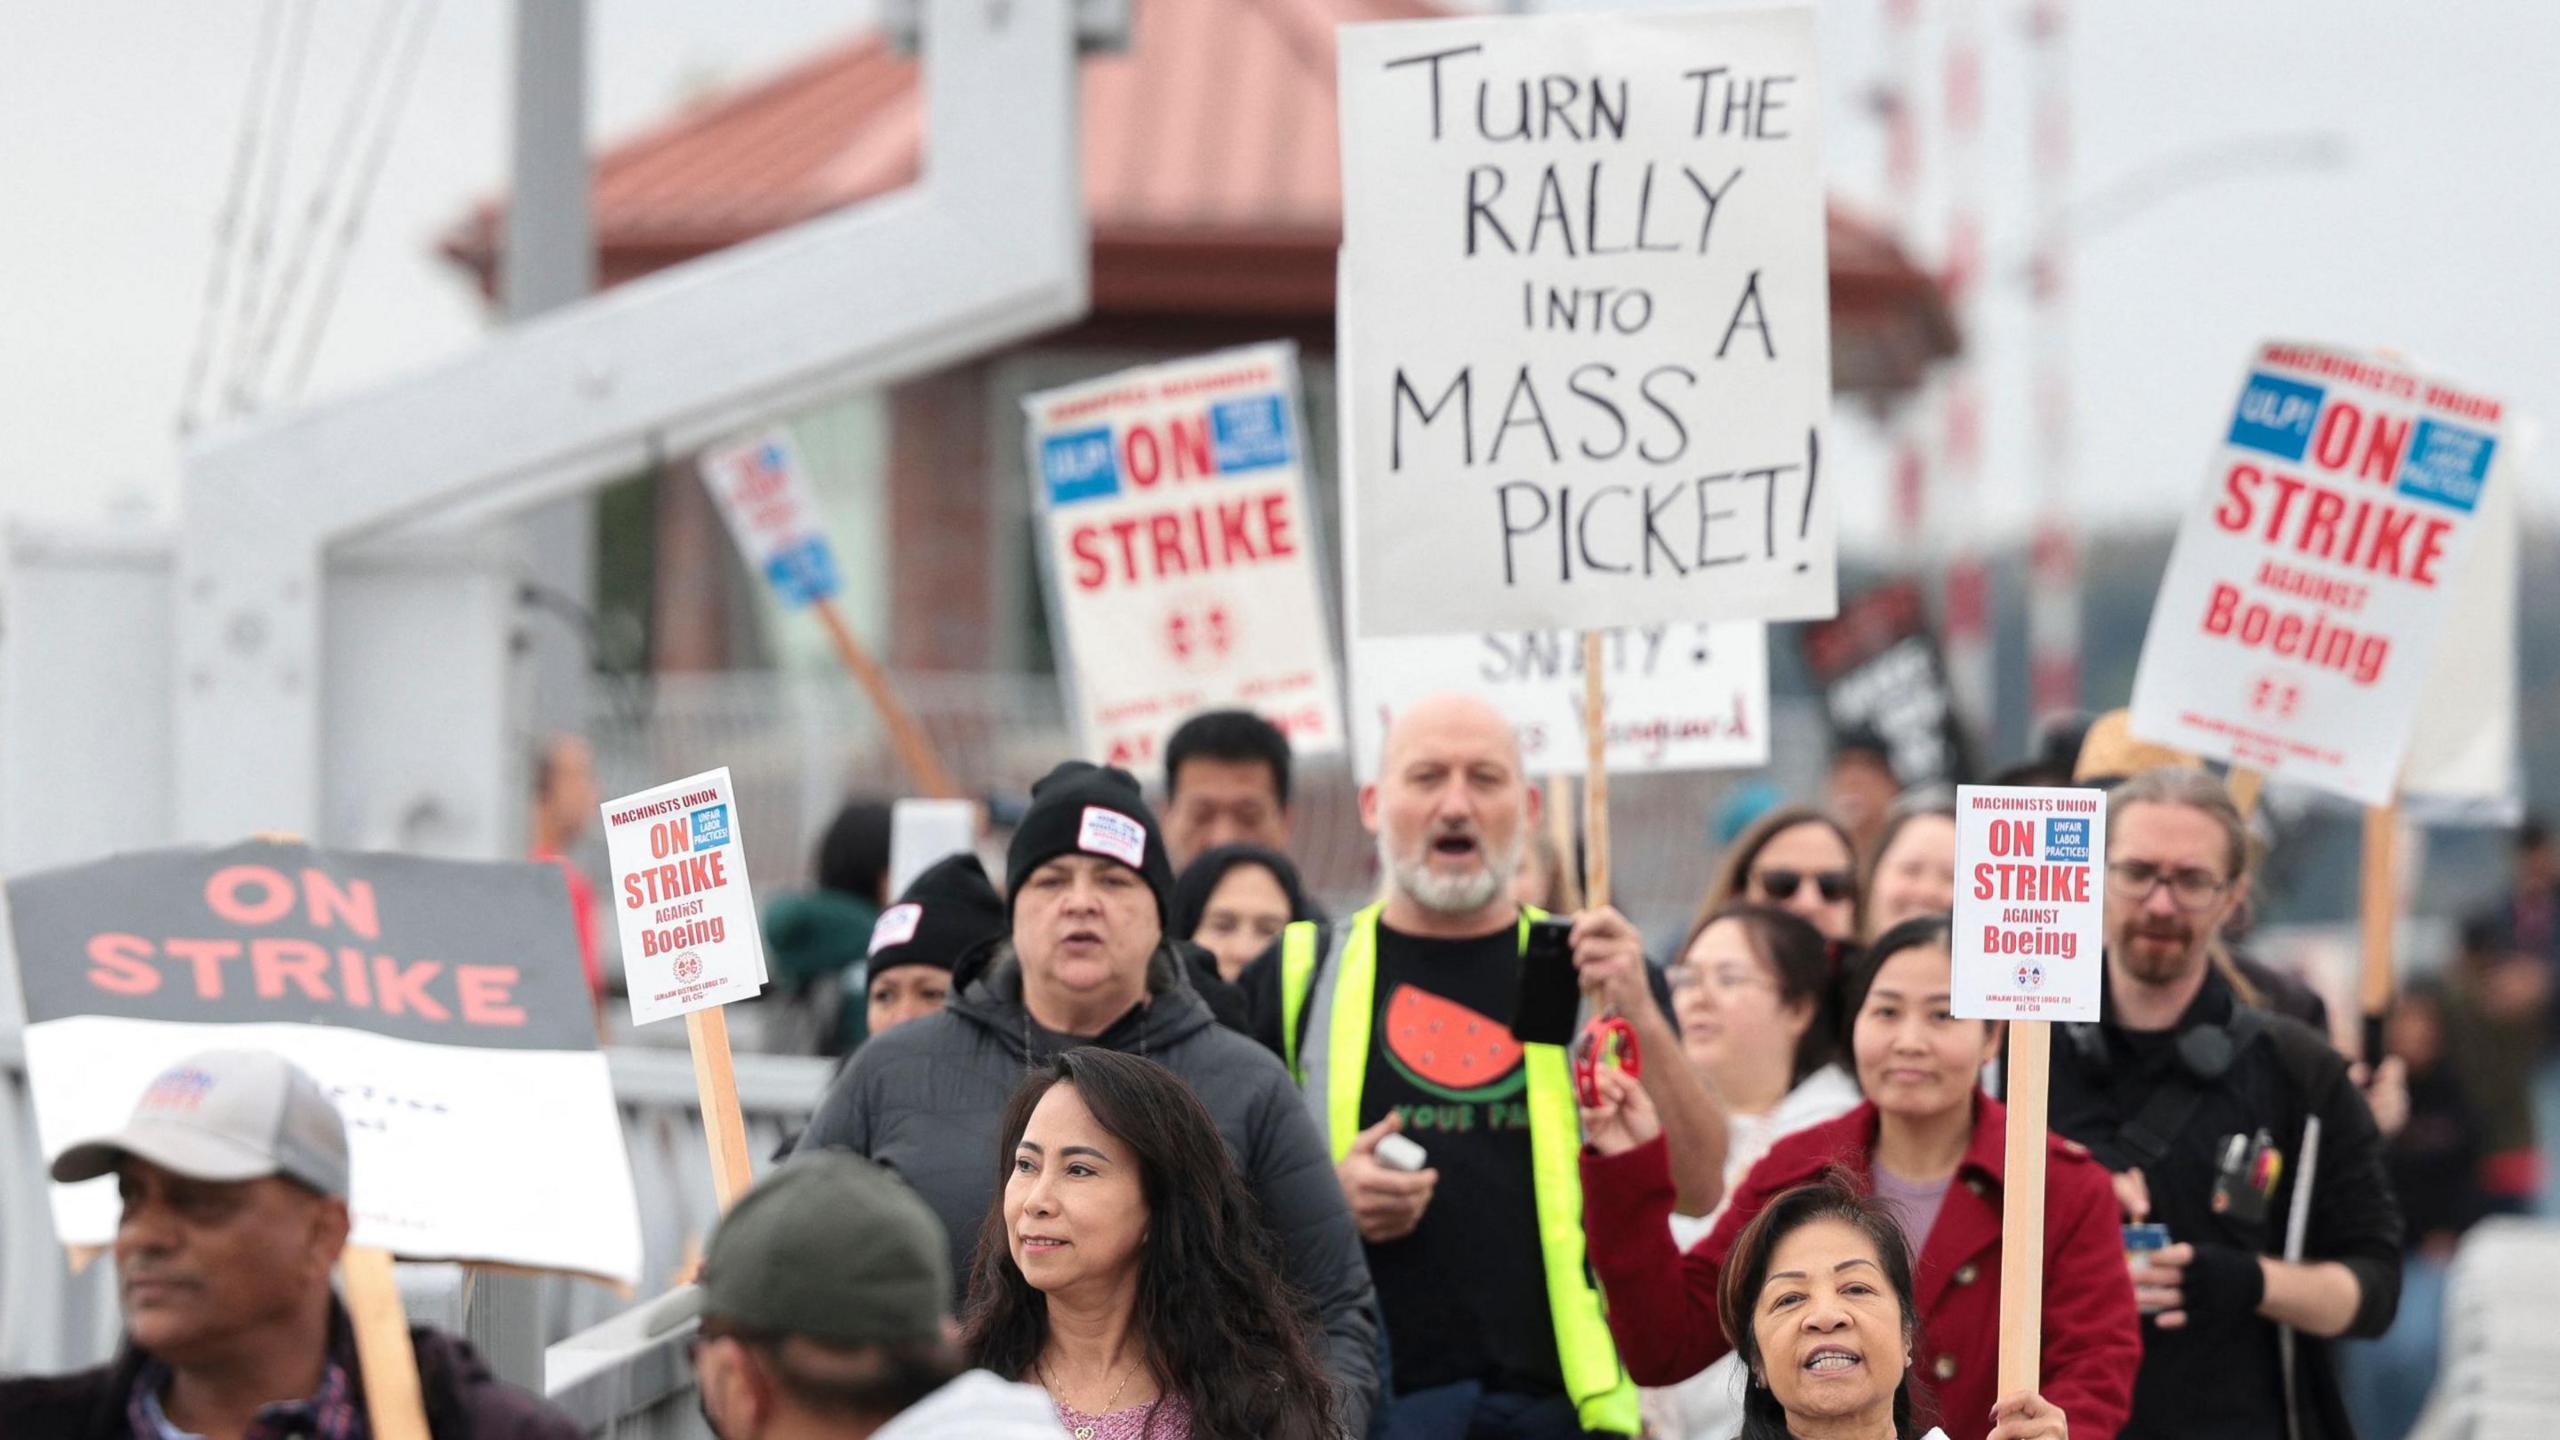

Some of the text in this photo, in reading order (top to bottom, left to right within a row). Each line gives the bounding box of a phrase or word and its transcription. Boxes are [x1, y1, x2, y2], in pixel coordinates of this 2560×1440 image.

[1384, 44, 1796, 142] TURN THE
[1464, 161, 1744, 259] RALLY
[1524, 269, 1777, 360] INTO A
[1390, 364, 1698, 472] MASS
[2316, 399, 2410, 485] ON
[1124, 416, 1213, 488] ON
[1497, 426, 1819, 585] PICKET!
[2214, 461, 2453, 589] STRIKE
[1071, 492, 1296, 591] STRIKE
[2201, 582, 2390, 684] Boeing
[611, 788, 718, 827] MACHINISTS UNION
[1972, 797, 2097, 812] MACHINISTS UNION
[2054, 821, 2082, 832] UNFAIR
[650, 817, 689, 859] ON
[1988, 819, 2035, 857] ON
[2045, 846, 2089, 858] PRACTICES!
[2055, 834, 2080, 845] LABOR
[205, 864, 380, 940] ON
[624, 850, 727, 909] STRIKE
[1973, 863, 2090, 903] STRIKE
[642, 915, 726, 957] Boeing
[655, 899, 703, 924] AGAINST
[2002, 908, 2059, 924] AGAINST
[1983, 925, 2077, 960] Boeing
[86, 932, 527, 1027] STRIKE
